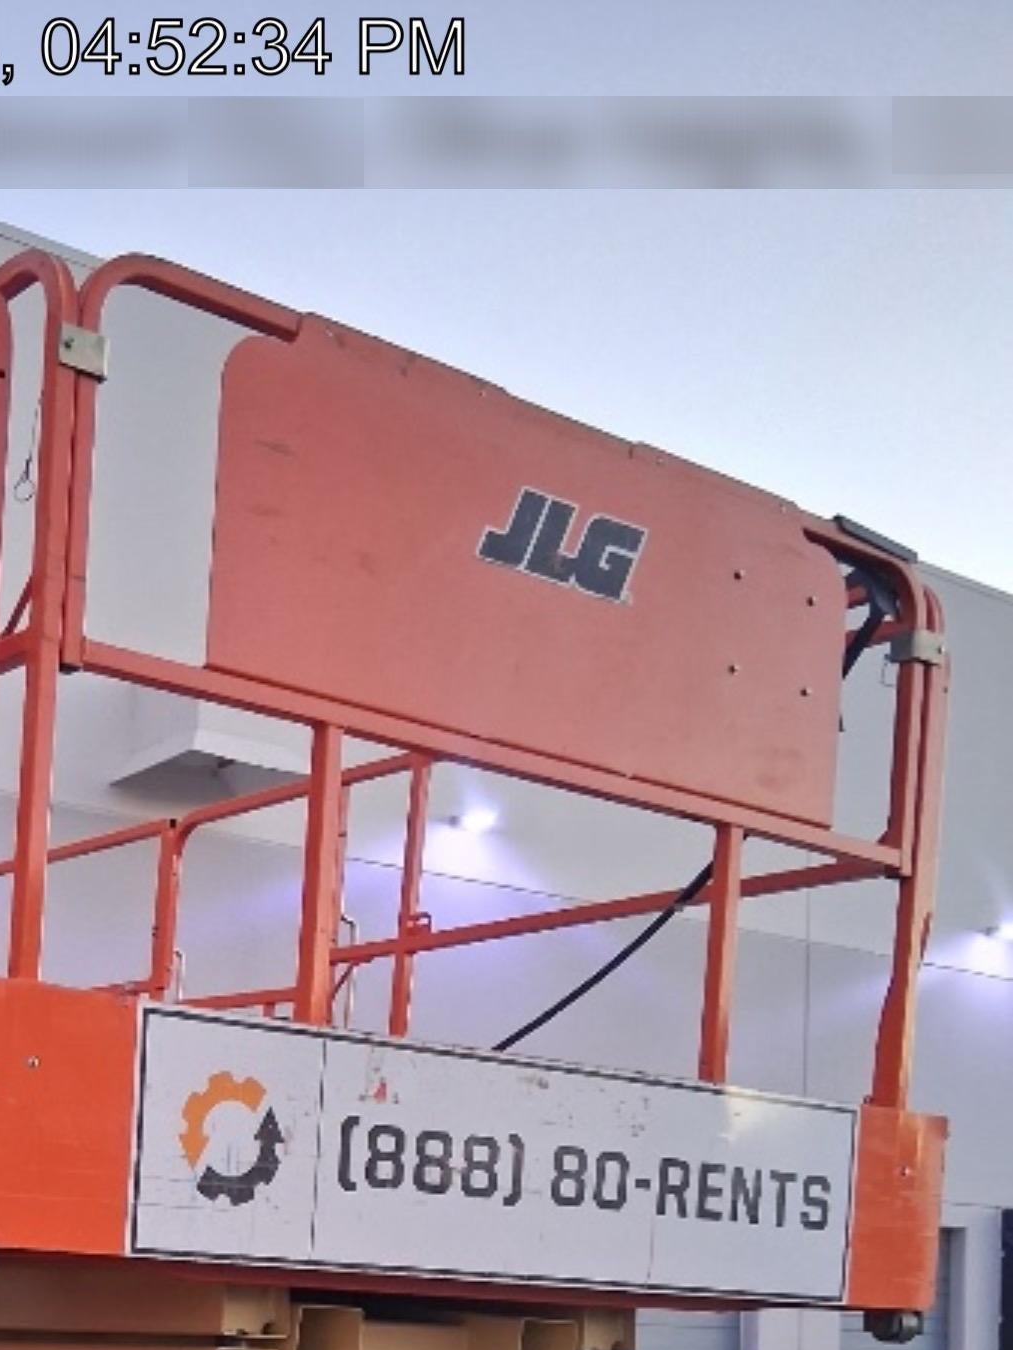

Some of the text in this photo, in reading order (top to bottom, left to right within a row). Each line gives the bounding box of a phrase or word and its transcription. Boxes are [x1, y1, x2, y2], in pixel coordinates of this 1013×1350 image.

[476, 486, 648, 604] JLG
[337, 1115, 833, 1231] (888) 80-RENTS
